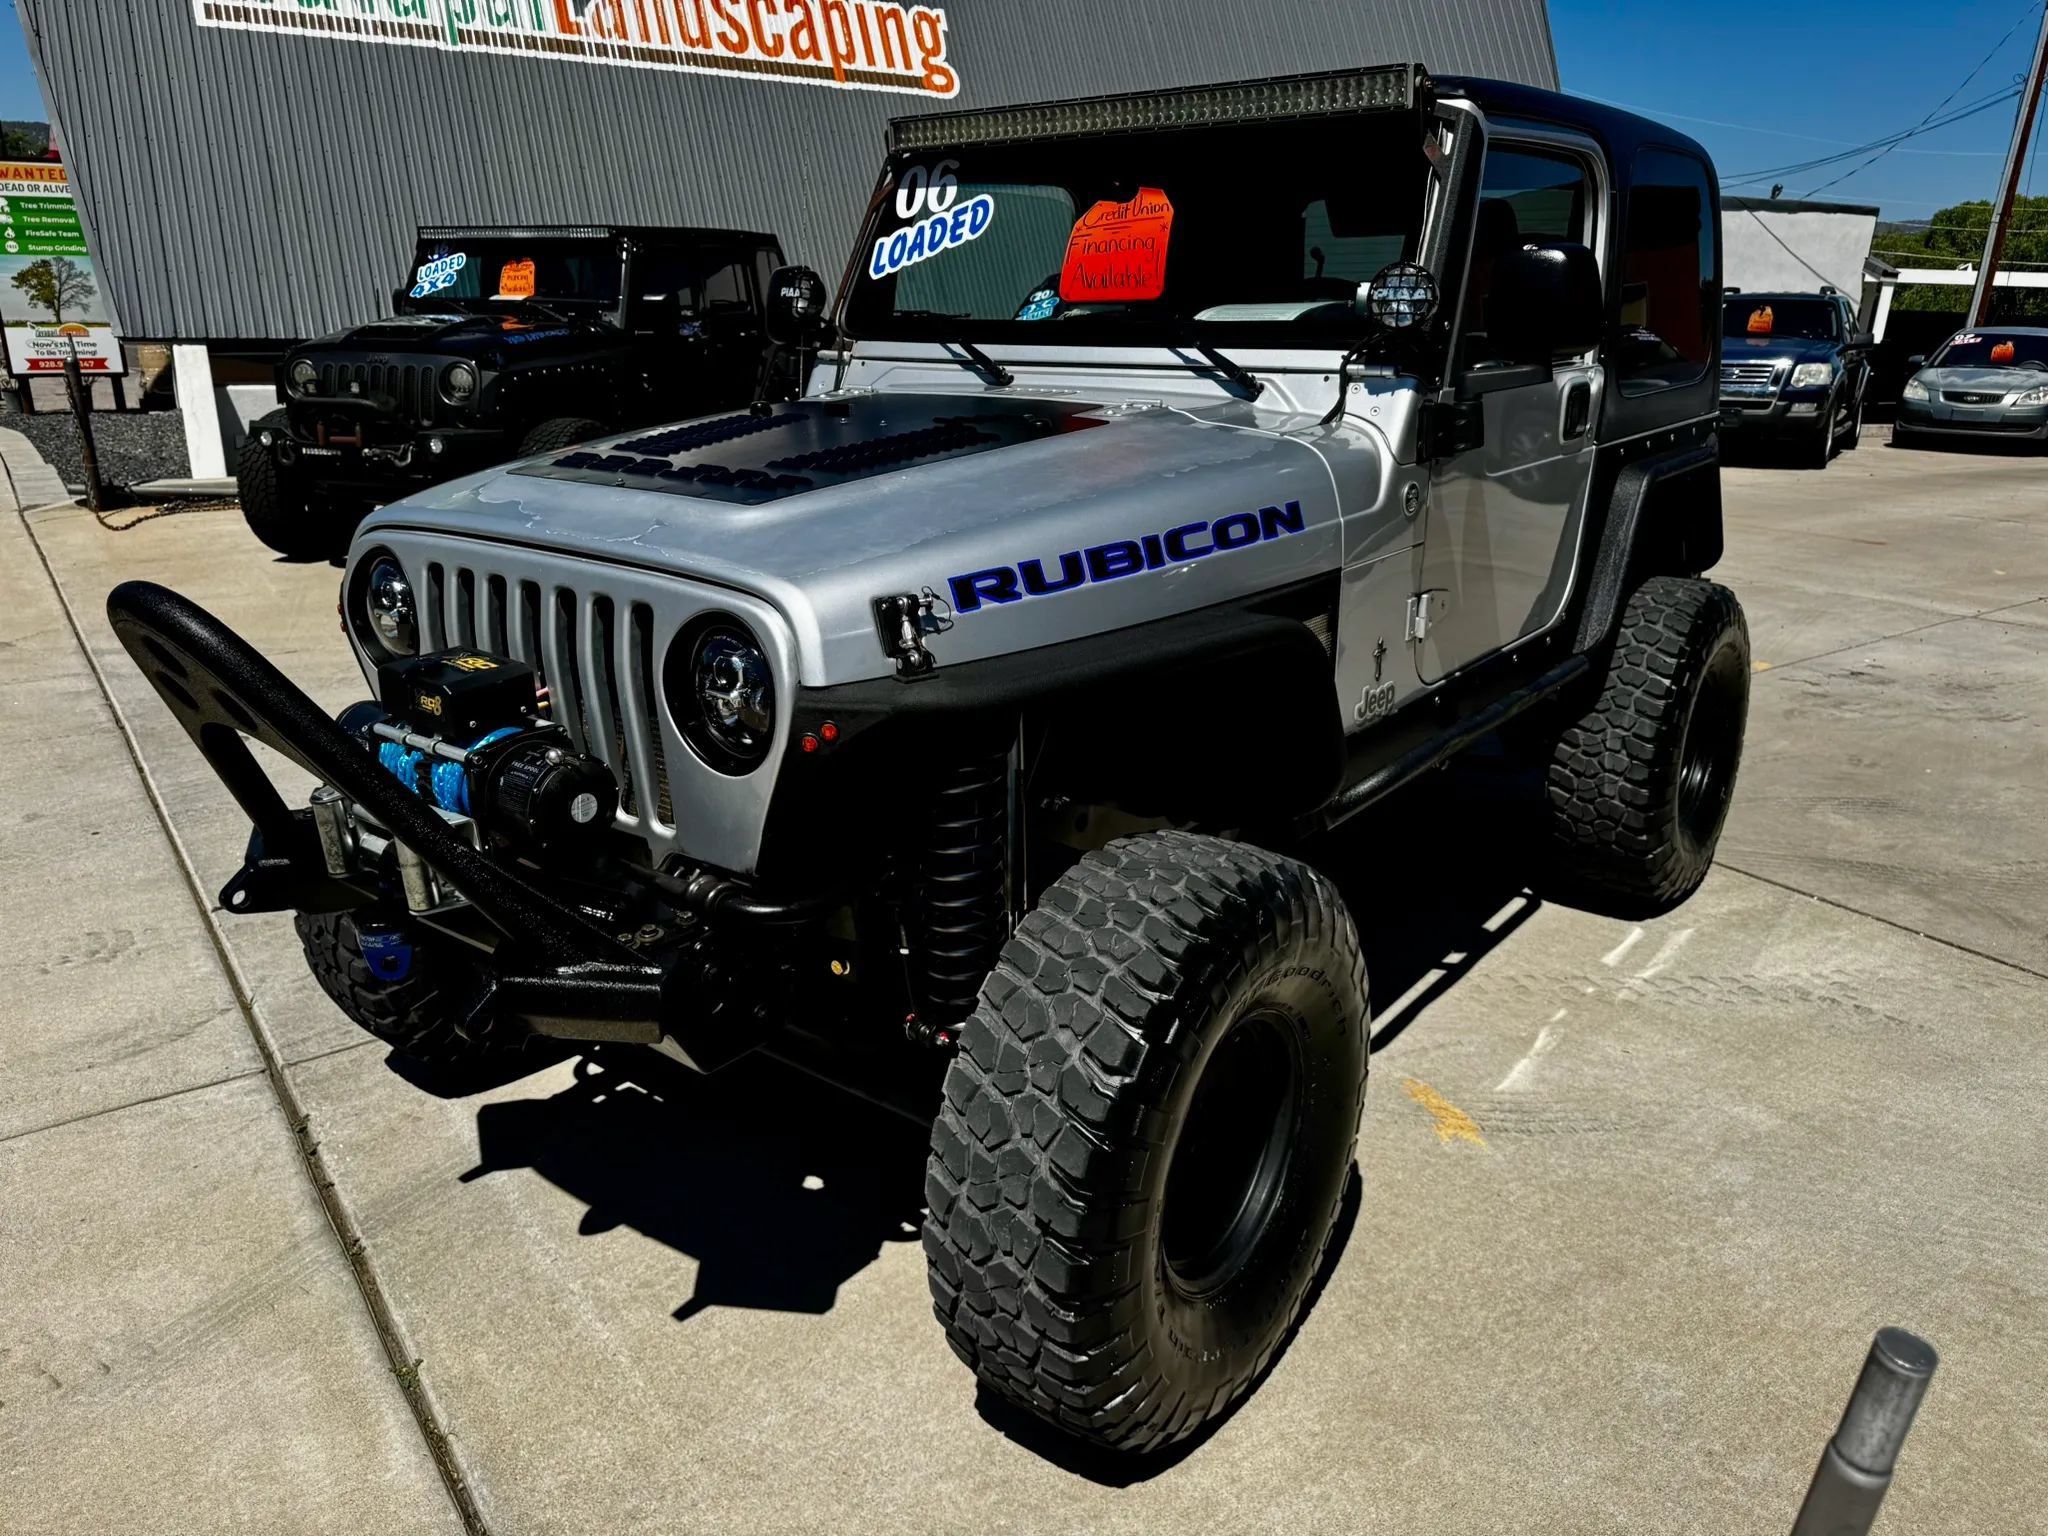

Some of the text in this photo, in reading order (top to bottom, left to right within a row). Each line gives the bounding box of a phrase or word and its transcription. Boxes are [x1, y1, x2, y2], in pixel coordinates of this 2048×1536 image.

[27, 184, 41, 192] OR
[43, 185, 72, 193] ALIVE
[896, 160, 960, 219] 06
[1083, 194, 1170, 227] Credit Union
[54, 245, 87, 253] Grinding
[872, 198, 991, 276] LOADED
[1066, 233, 1156, 264] Financing
[418, 254, 464, 281] LOADED
[781, 287, 800, 297] PIAA
[1373, 287, 1426, 300] PIAA
[948, 500, 1305, 614] RUBICON
[1355, 681, 1395, 720] Jeep
